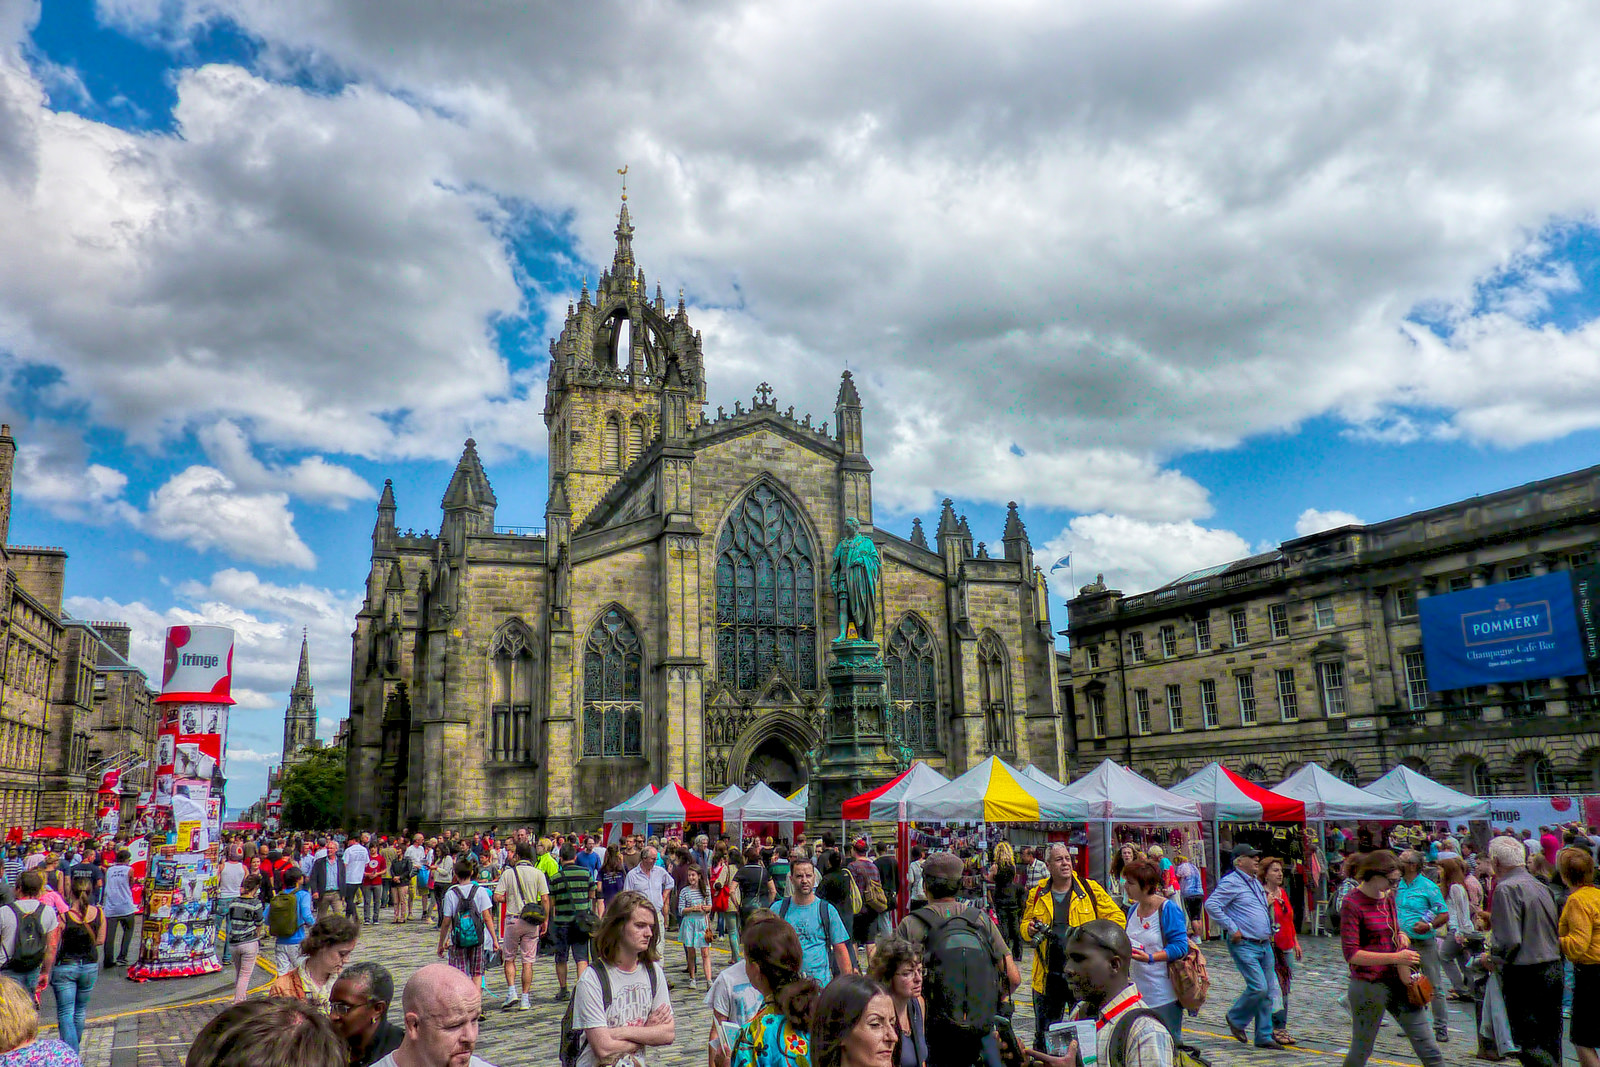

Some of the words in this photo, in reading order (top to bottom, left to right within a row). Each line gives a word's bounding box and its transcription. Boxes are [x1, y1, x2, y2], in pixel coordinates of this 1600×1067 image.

[1473, 614, 1540, 635] POMMERY
[1466, 648, 1514, 661] Champagne
[1539, 640, 1556, 651] Bar
[182, 653, 219, 668] fringe
[1491, 809, 1520, 822] ringe
